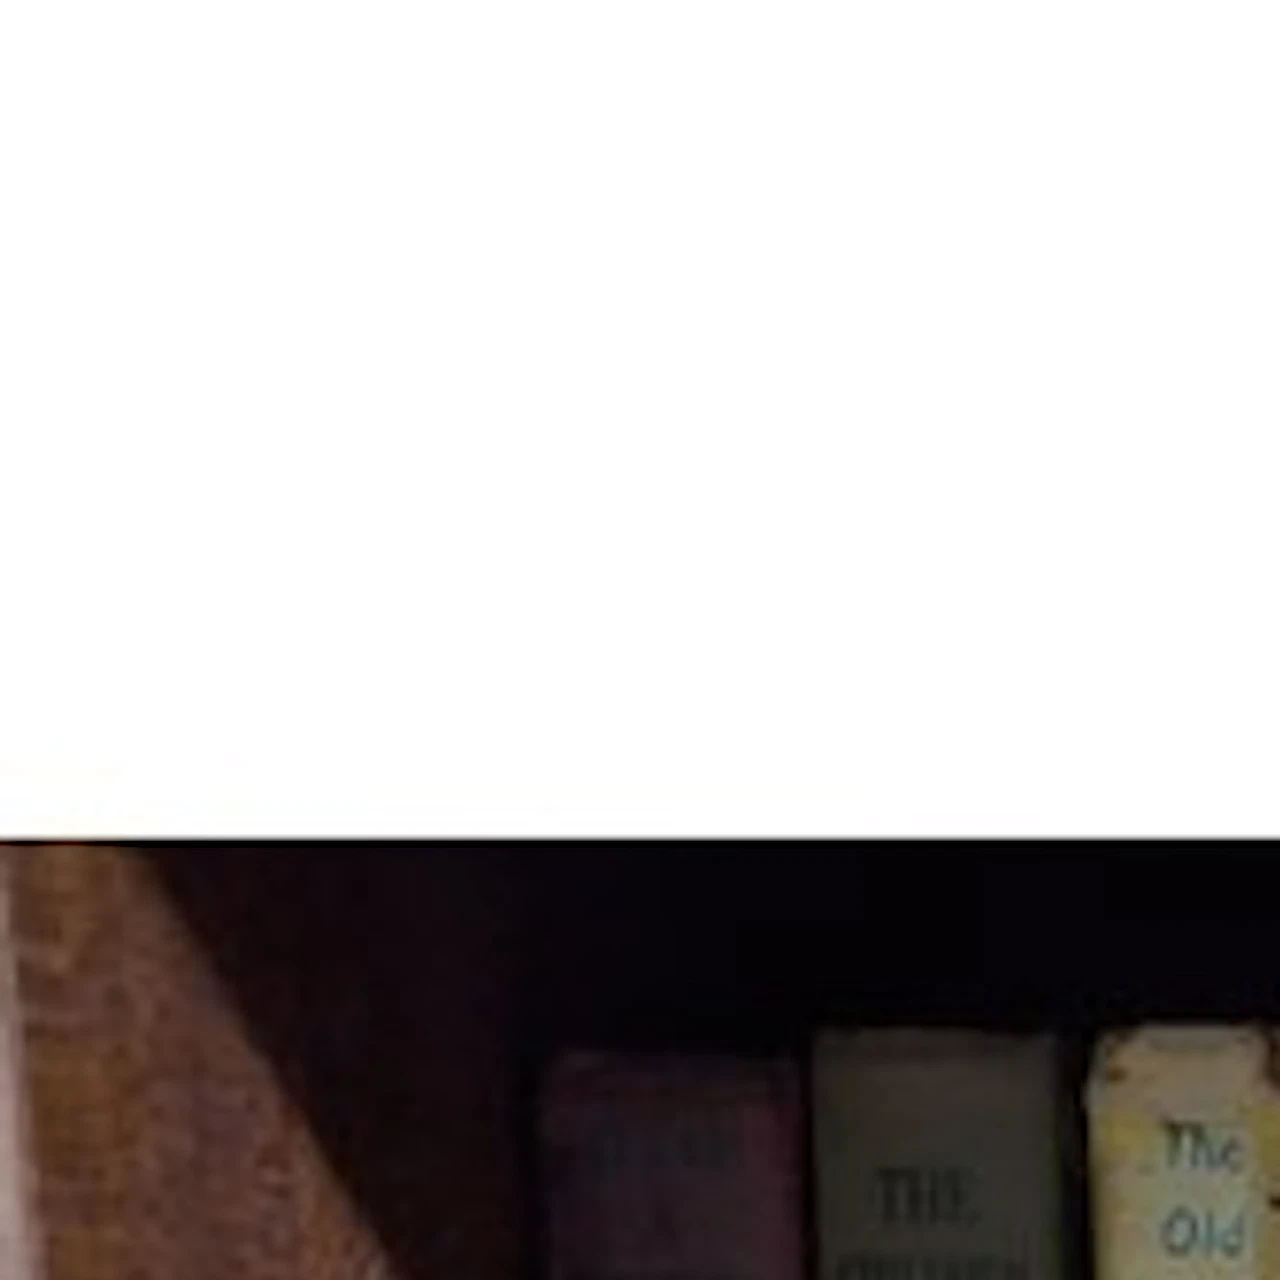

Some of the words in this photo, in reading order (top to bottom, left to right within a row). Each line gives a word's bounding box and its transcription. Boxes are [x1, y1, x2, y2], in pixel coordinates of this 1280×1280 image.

[1161, 1120, 1245, 1176] The
[872, 1166, 986, 1229] THE
[1160, 1205, 1248, 1259] Old
